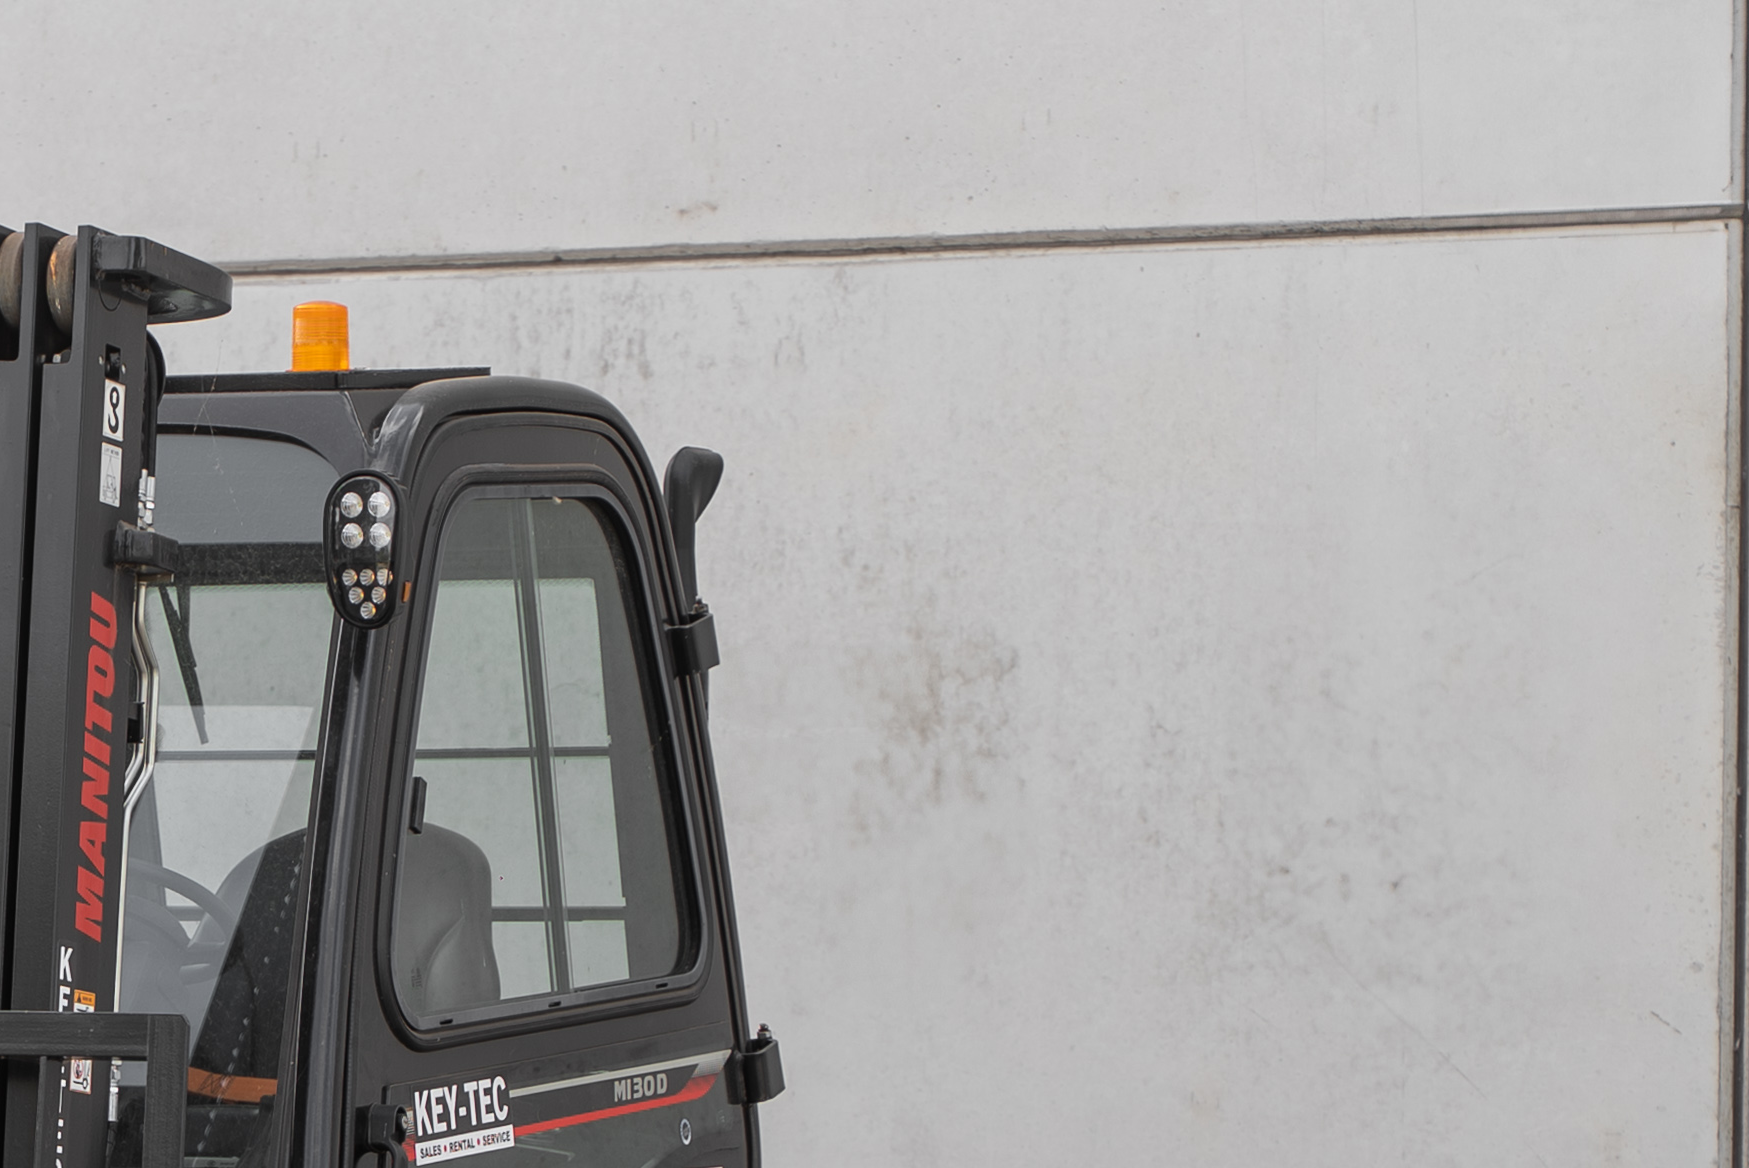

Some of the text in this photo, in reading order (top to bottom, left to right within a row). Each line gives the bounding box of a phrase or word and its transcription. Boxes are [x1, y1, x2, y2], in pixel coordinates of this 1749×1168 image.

[74, 590, 118, 944] MANITOU
[413, 1075, 509, 1137] KEY-TEC
[420, 1130, 511, 1159] SALES RENTAL SERVICE
